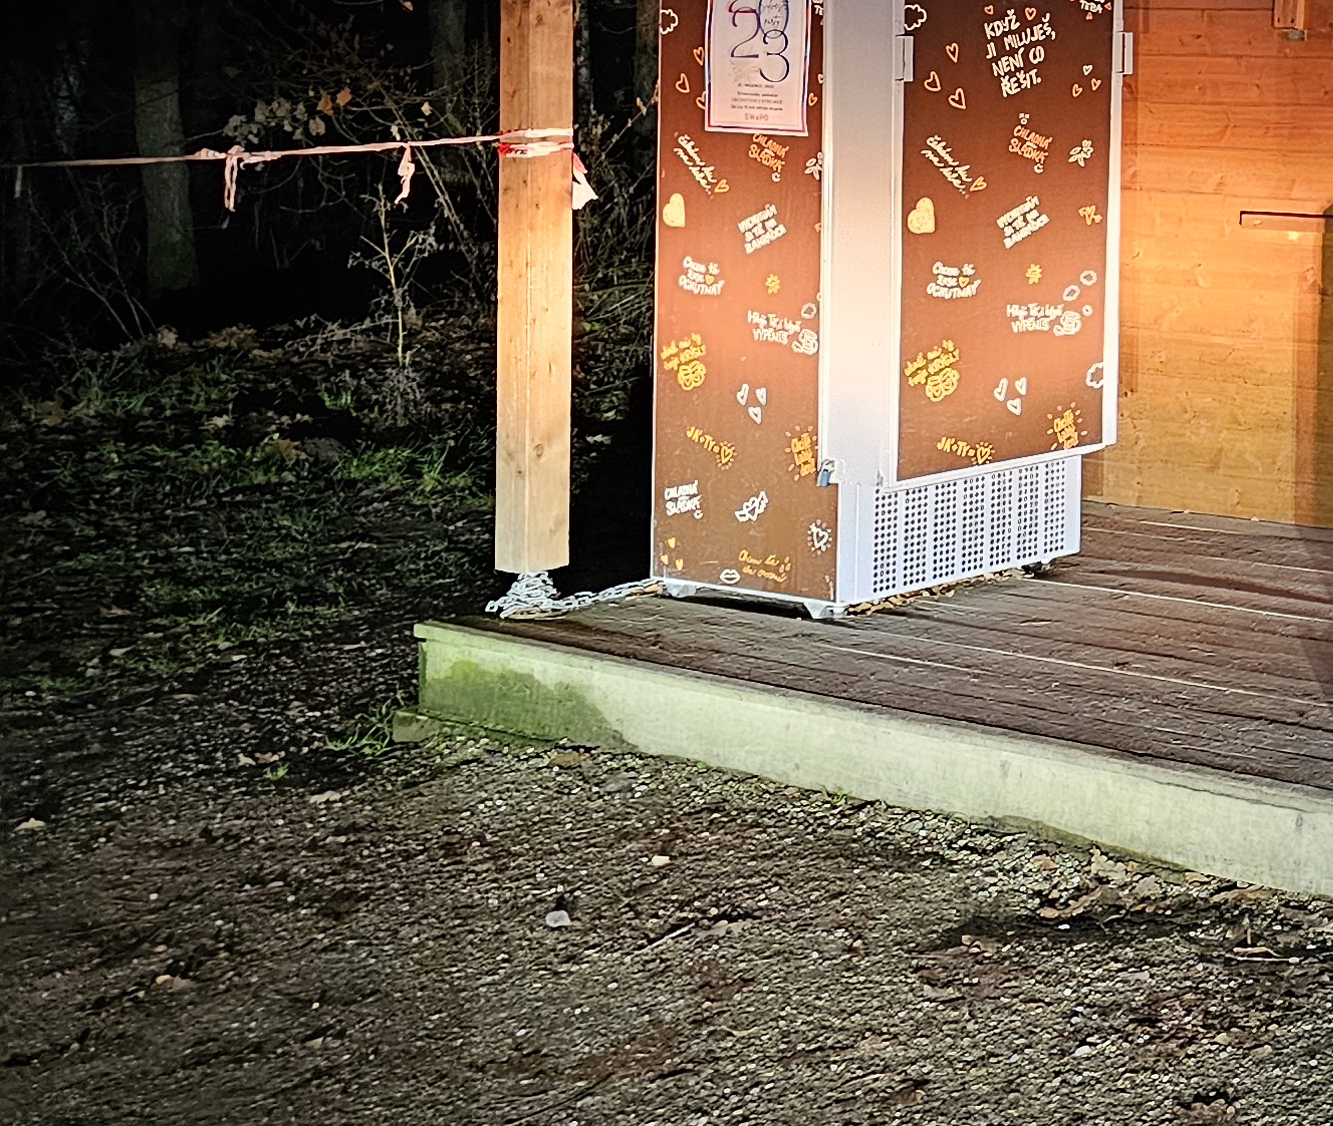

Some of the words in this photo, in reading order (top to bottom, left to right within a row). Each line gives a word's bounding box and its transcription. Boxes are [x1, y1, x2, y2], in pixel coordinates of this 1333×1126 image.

[984, 9, 1020, 39] KDYŽ
[992, 49, 1024, 77] NENÍ
[1029, 46, 1045, 65] CO
